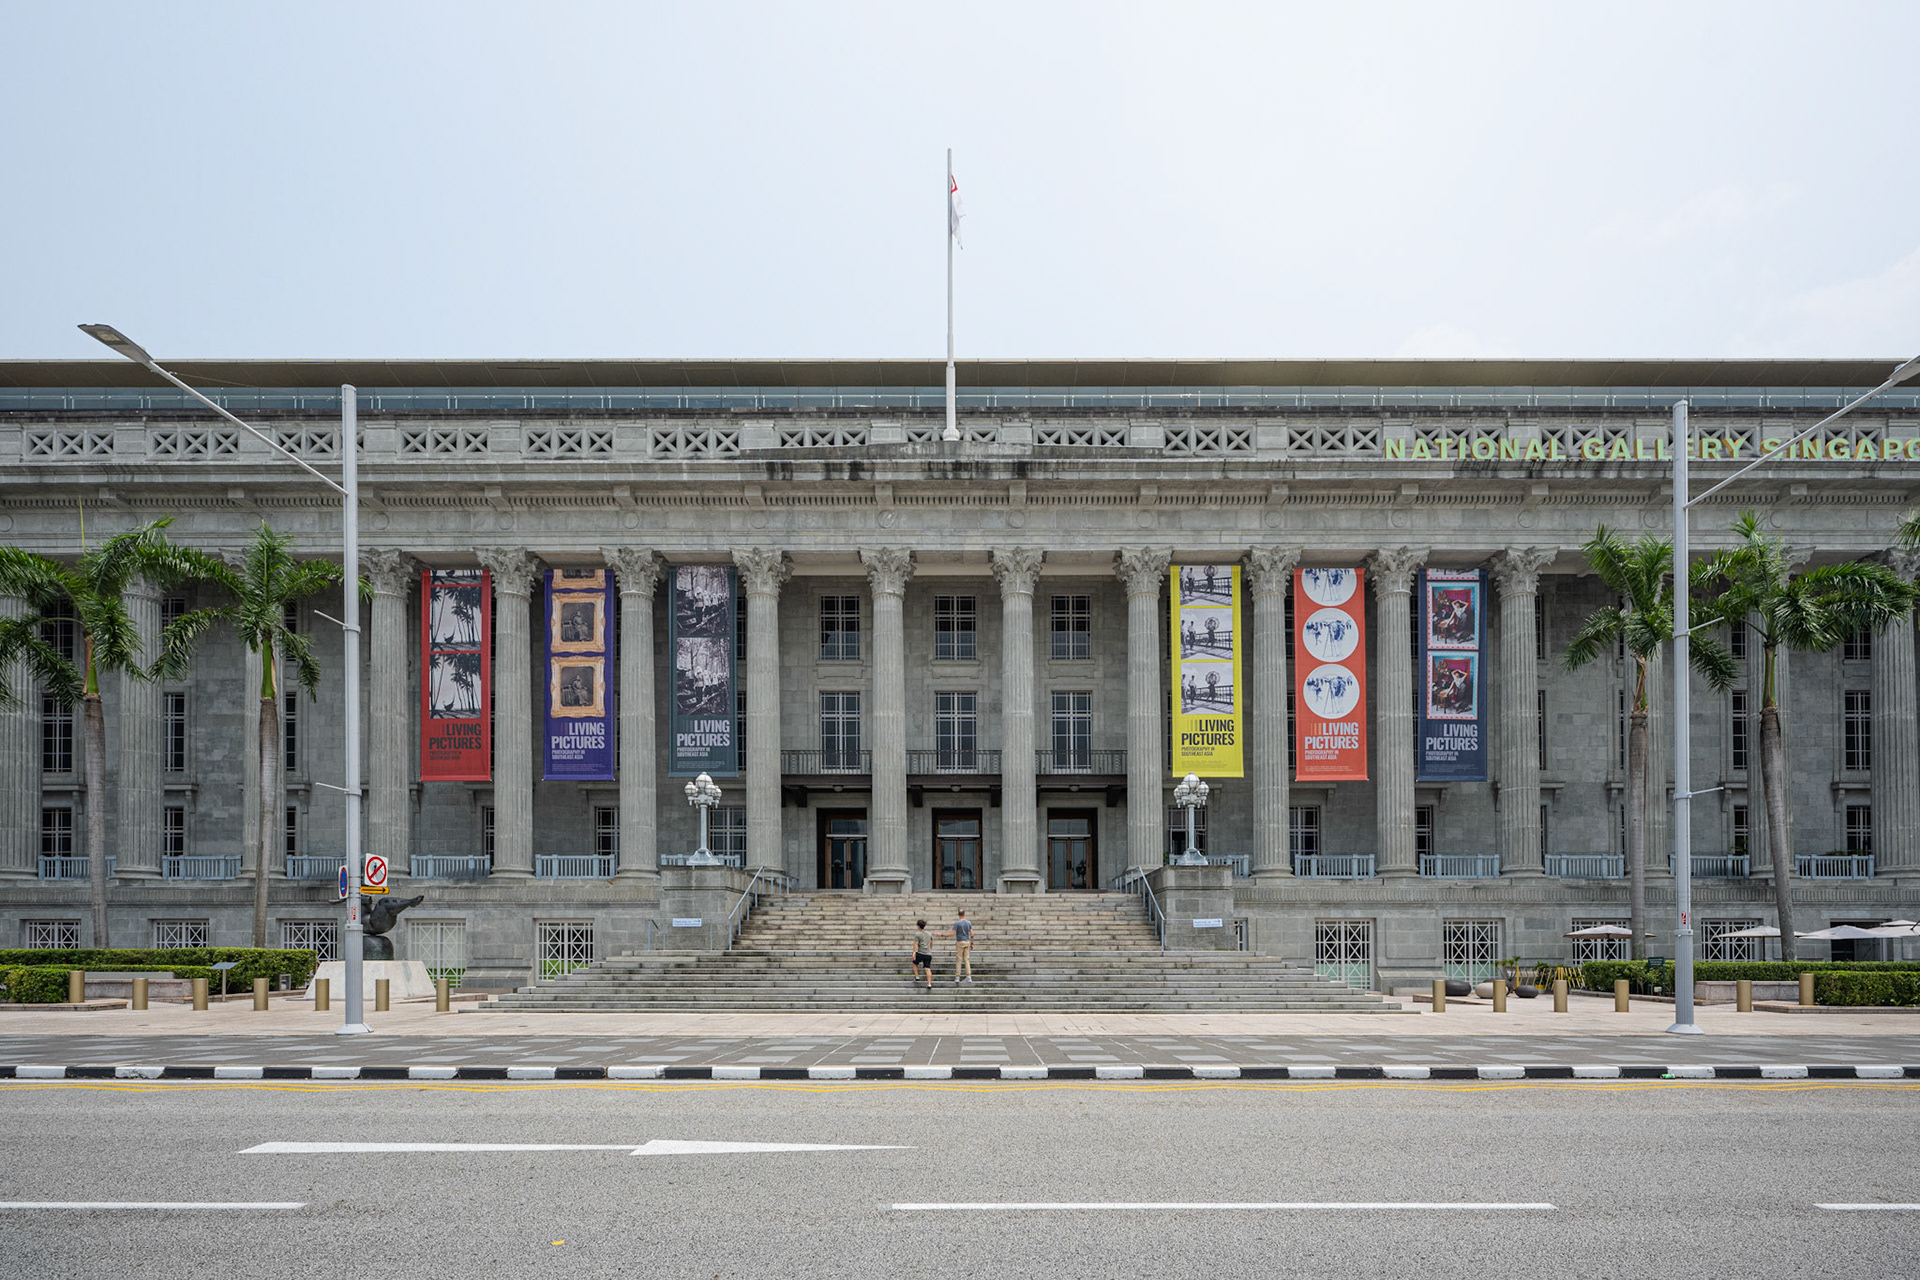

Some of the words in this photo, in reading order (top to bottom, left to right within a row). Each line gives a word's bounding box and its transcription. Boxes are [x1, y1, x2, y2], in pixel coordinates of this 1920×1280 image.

[1384, 436, 1567, 460] NATIONAL
[446, 723, 482, 736] LIVING
[569, 722, 605, 736] LIVING
[694, 719, 730, 733] LIVING
[1199, 719, 1235, 732] LIVING
[1322, 721, 1359, 736] LIVING
[1443, 723, 1479, 737] LIVING
[429, 736, 482, 750] PICTURES
[551, 735, 606, 749] PICTURES
[676, 733, 731, 747] PICTURES
[1181, 732, 1235, 746] PICTURES
[1304, 735, 1360, 750] PICTURES
[1425, 737, 1479, 751] PICTURES
